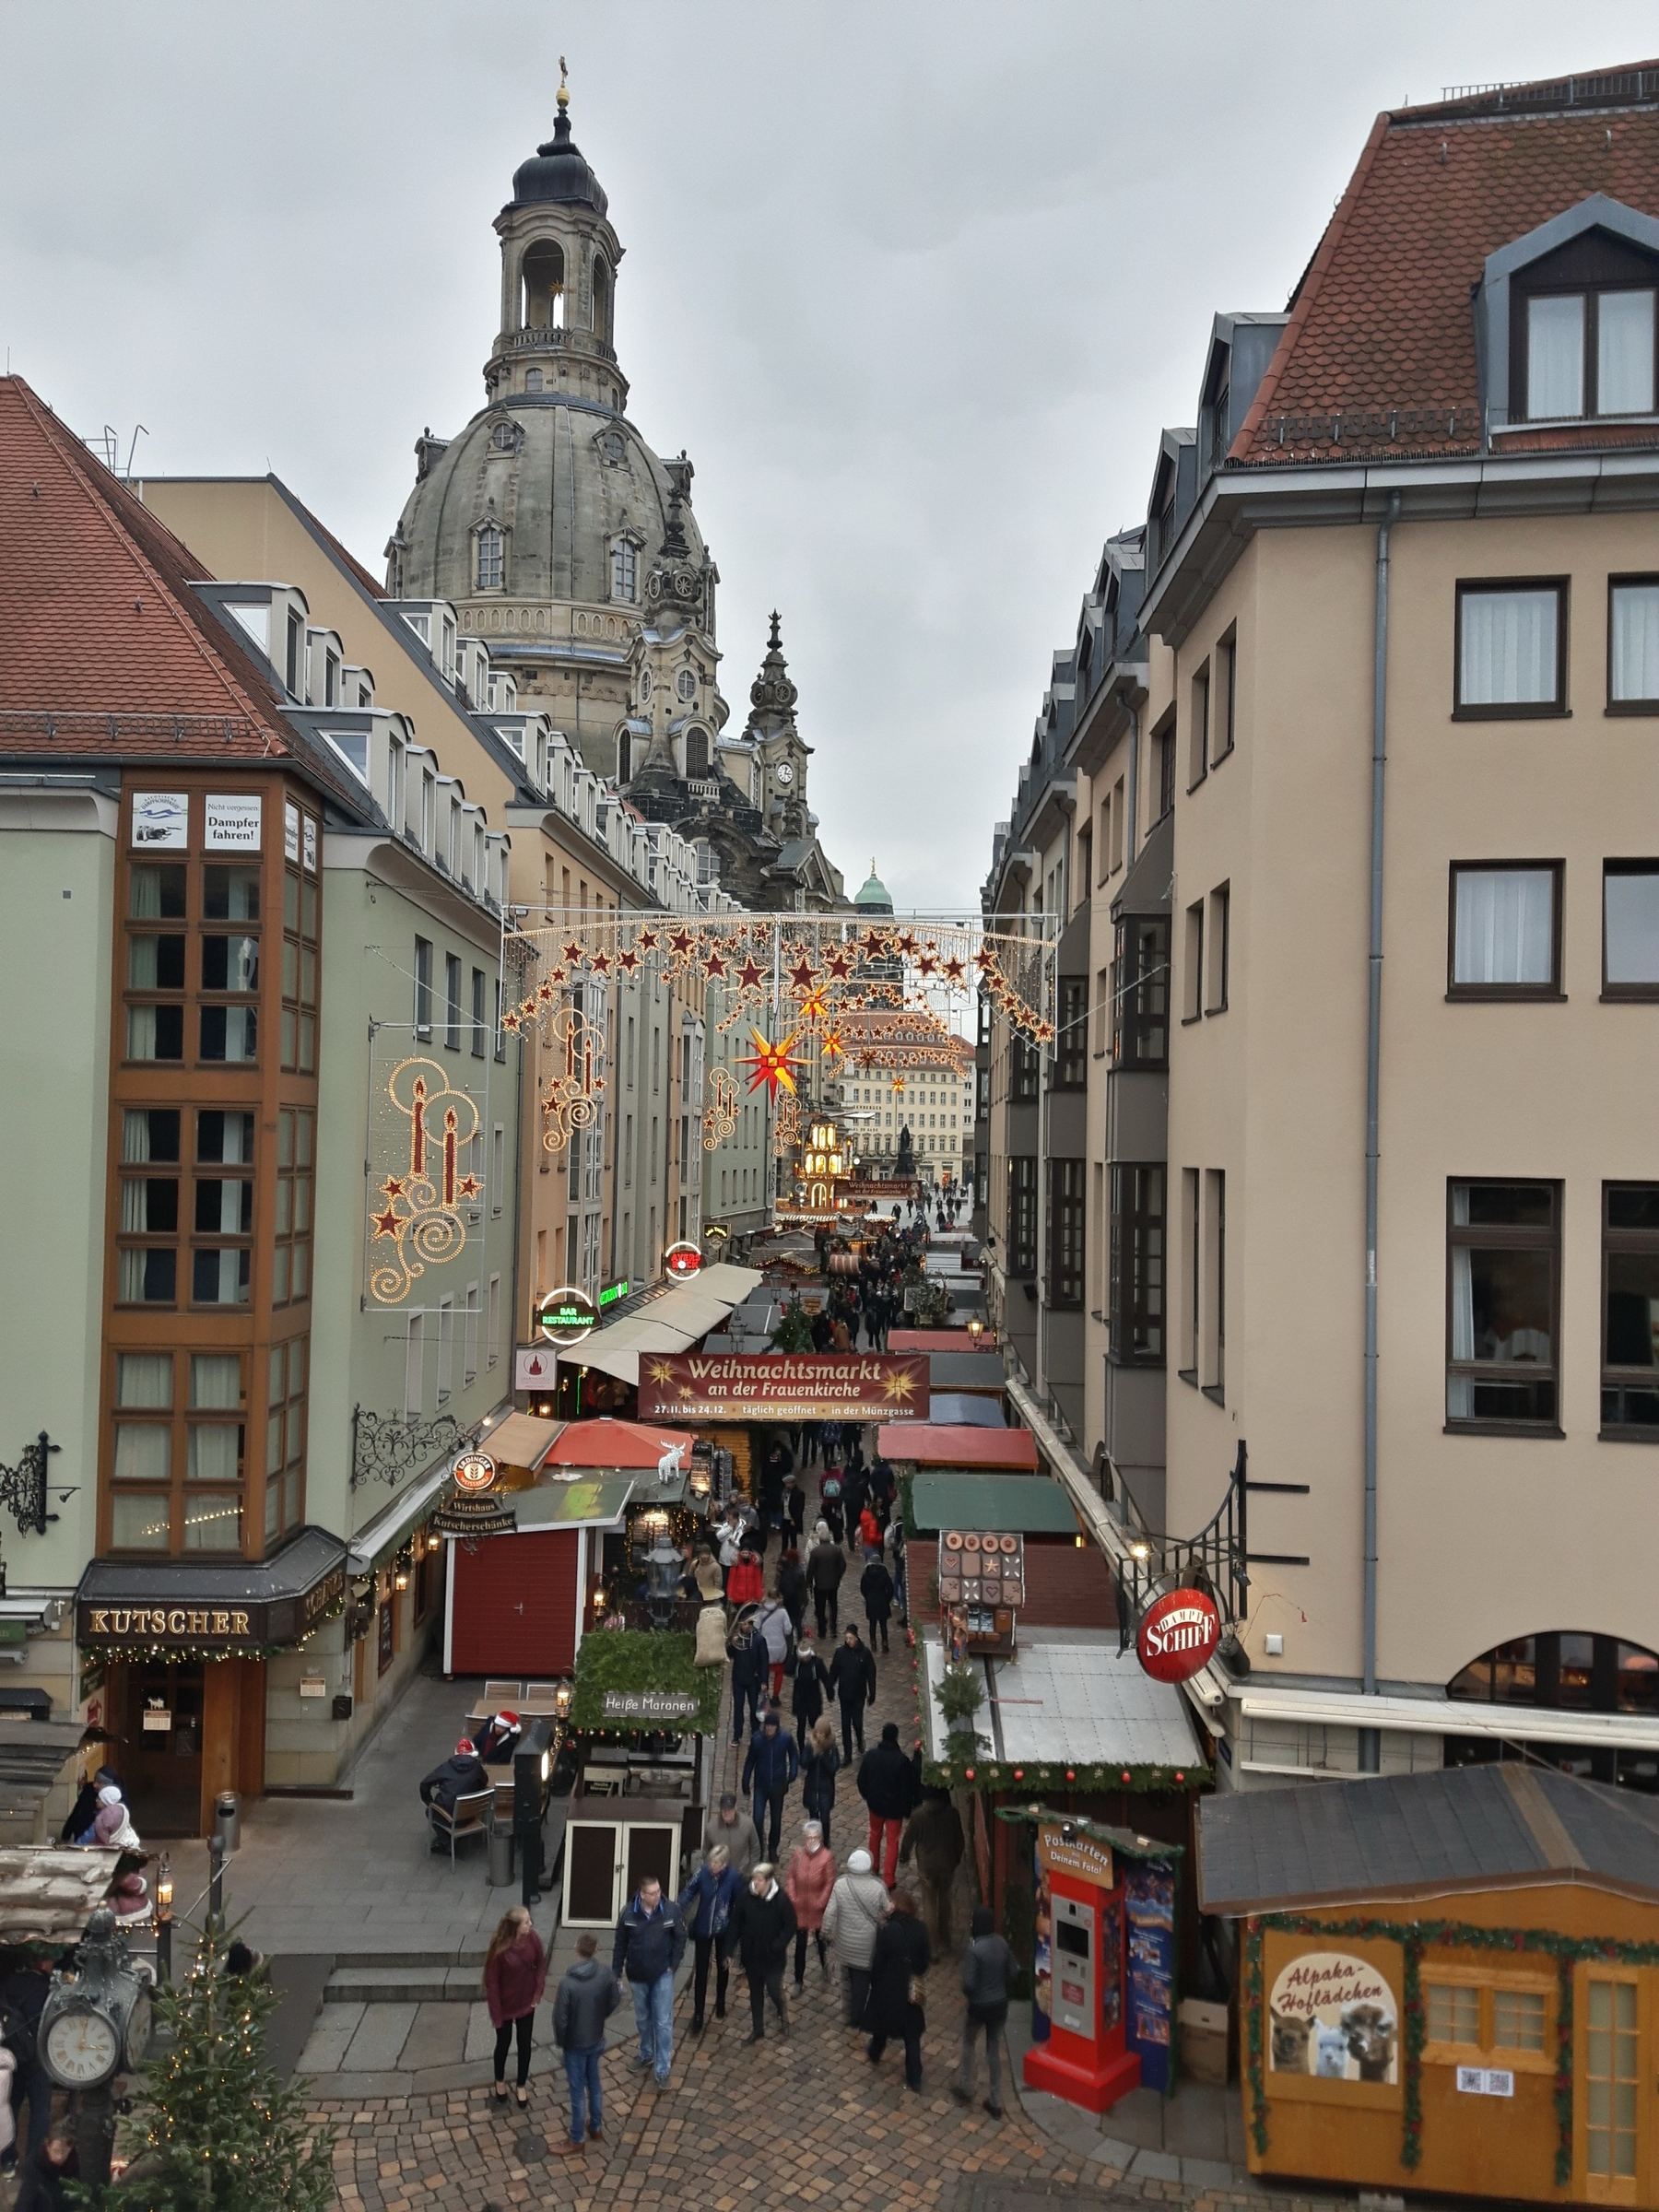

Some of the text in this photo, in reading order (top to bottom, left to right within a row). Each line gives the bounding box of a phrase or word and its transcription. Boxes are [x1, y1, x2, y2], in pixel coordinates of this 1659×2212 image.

[207, 803, 225, 811] Nicht
[208, 817, 259, 830] Dampfer
[213, 830, 254, 841] fahren!
[559, 1307, 577, 1316] BAR
[542, 1315, 594, 1325] RESTAURANT
[688, 1359, 881, 1381] Weihnachtsmarkt
[708, 1382, 861, 1397] an der Frauenkirche
[682, 1405, 697, 1415] bis
[742, 1404, 774, 1417] täglich
[777, 1405, 817, 1418] geöffnet
[831, 1406, 841, 1415] in
[843, 1406, 859, 1416] der
[861, 1406, 914, 1418] Münzgasse
[458, 1455, 491, 1471] ERDINGER
[453, 1501, 495, 1512] Wirtshaus
[433, 1516, 513, 1531] Kutscherschänke
[88, 1608, 251, 1635] KUTSCHER
[1161, 1610, 1203, 1630] DAMPF
[606, 1697, 694, 1712] Heiße Maronen
[1051, 1851, 1102, 1875] Deinem Foto!
[1277, 1982, 1382, 2016] Hoflädchen
